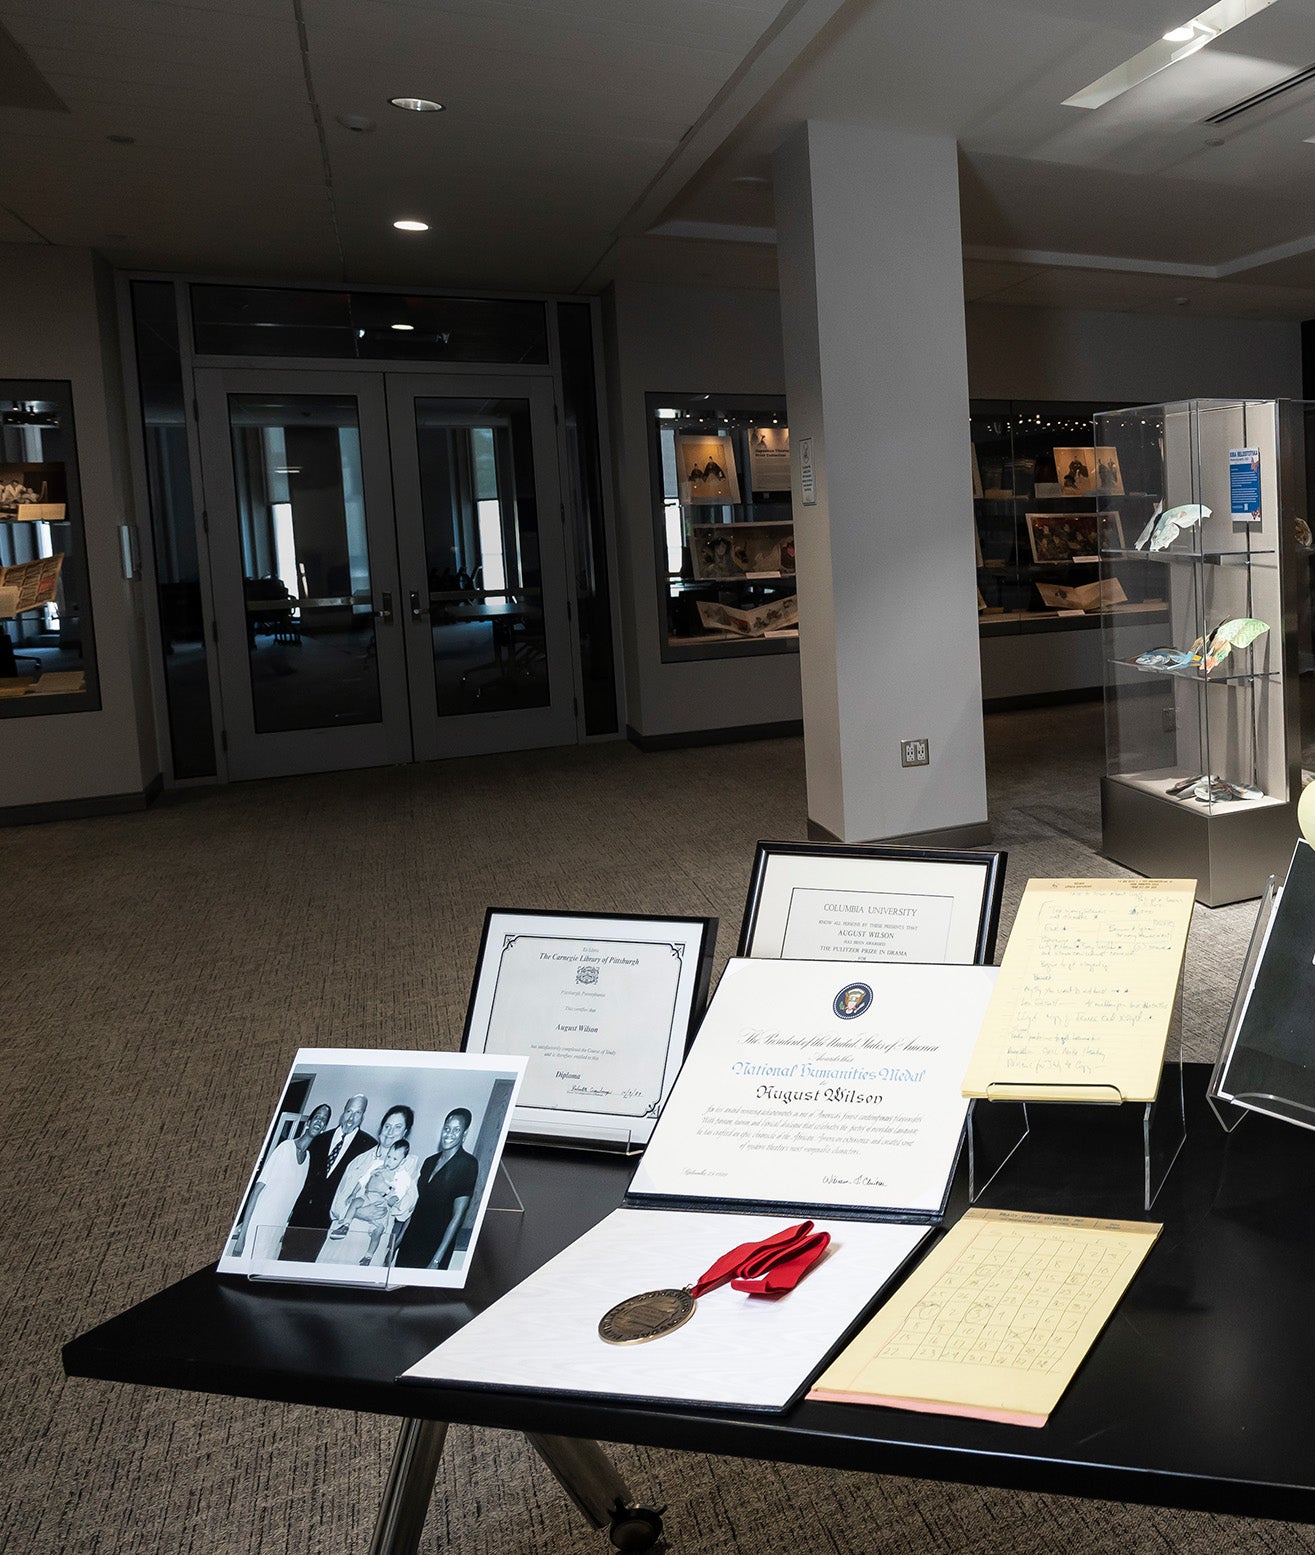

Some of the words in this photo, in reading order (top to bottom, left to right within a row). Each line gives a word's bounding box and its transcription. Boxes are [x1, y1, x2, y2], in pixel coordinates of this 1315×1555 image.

[824, 904, 864, 913] COLUMBIA
[868, 906, 918, 917] UNIVERSITY
[869, 931, 895, 939] WILSON
[540, 952, 551, 960] The
[552, 953, 579, 962] Carnegie
[580, 955, 601, 964] Library
[602, 956, 609, 965] of
[609, 957, 640, 966] Pittsburgh
[555, 1024, 578, 1033] August
[578, 1025, 599, 1033] Wilson
[764, 1033, 801, 1046] President
[826, 1036, 860, 1048] United
[902, 1036, 940, 1052] America
[555, 1070, 581, 1080] Diploma
[732, 1061, 798, 1078] National
[800, 1062, 876, 1081] Humanities
[878, 1067, 926, 1083] Medal
[756, 1085, 821, 1104] August
[824, 1086, 884, 1104] Wilson
